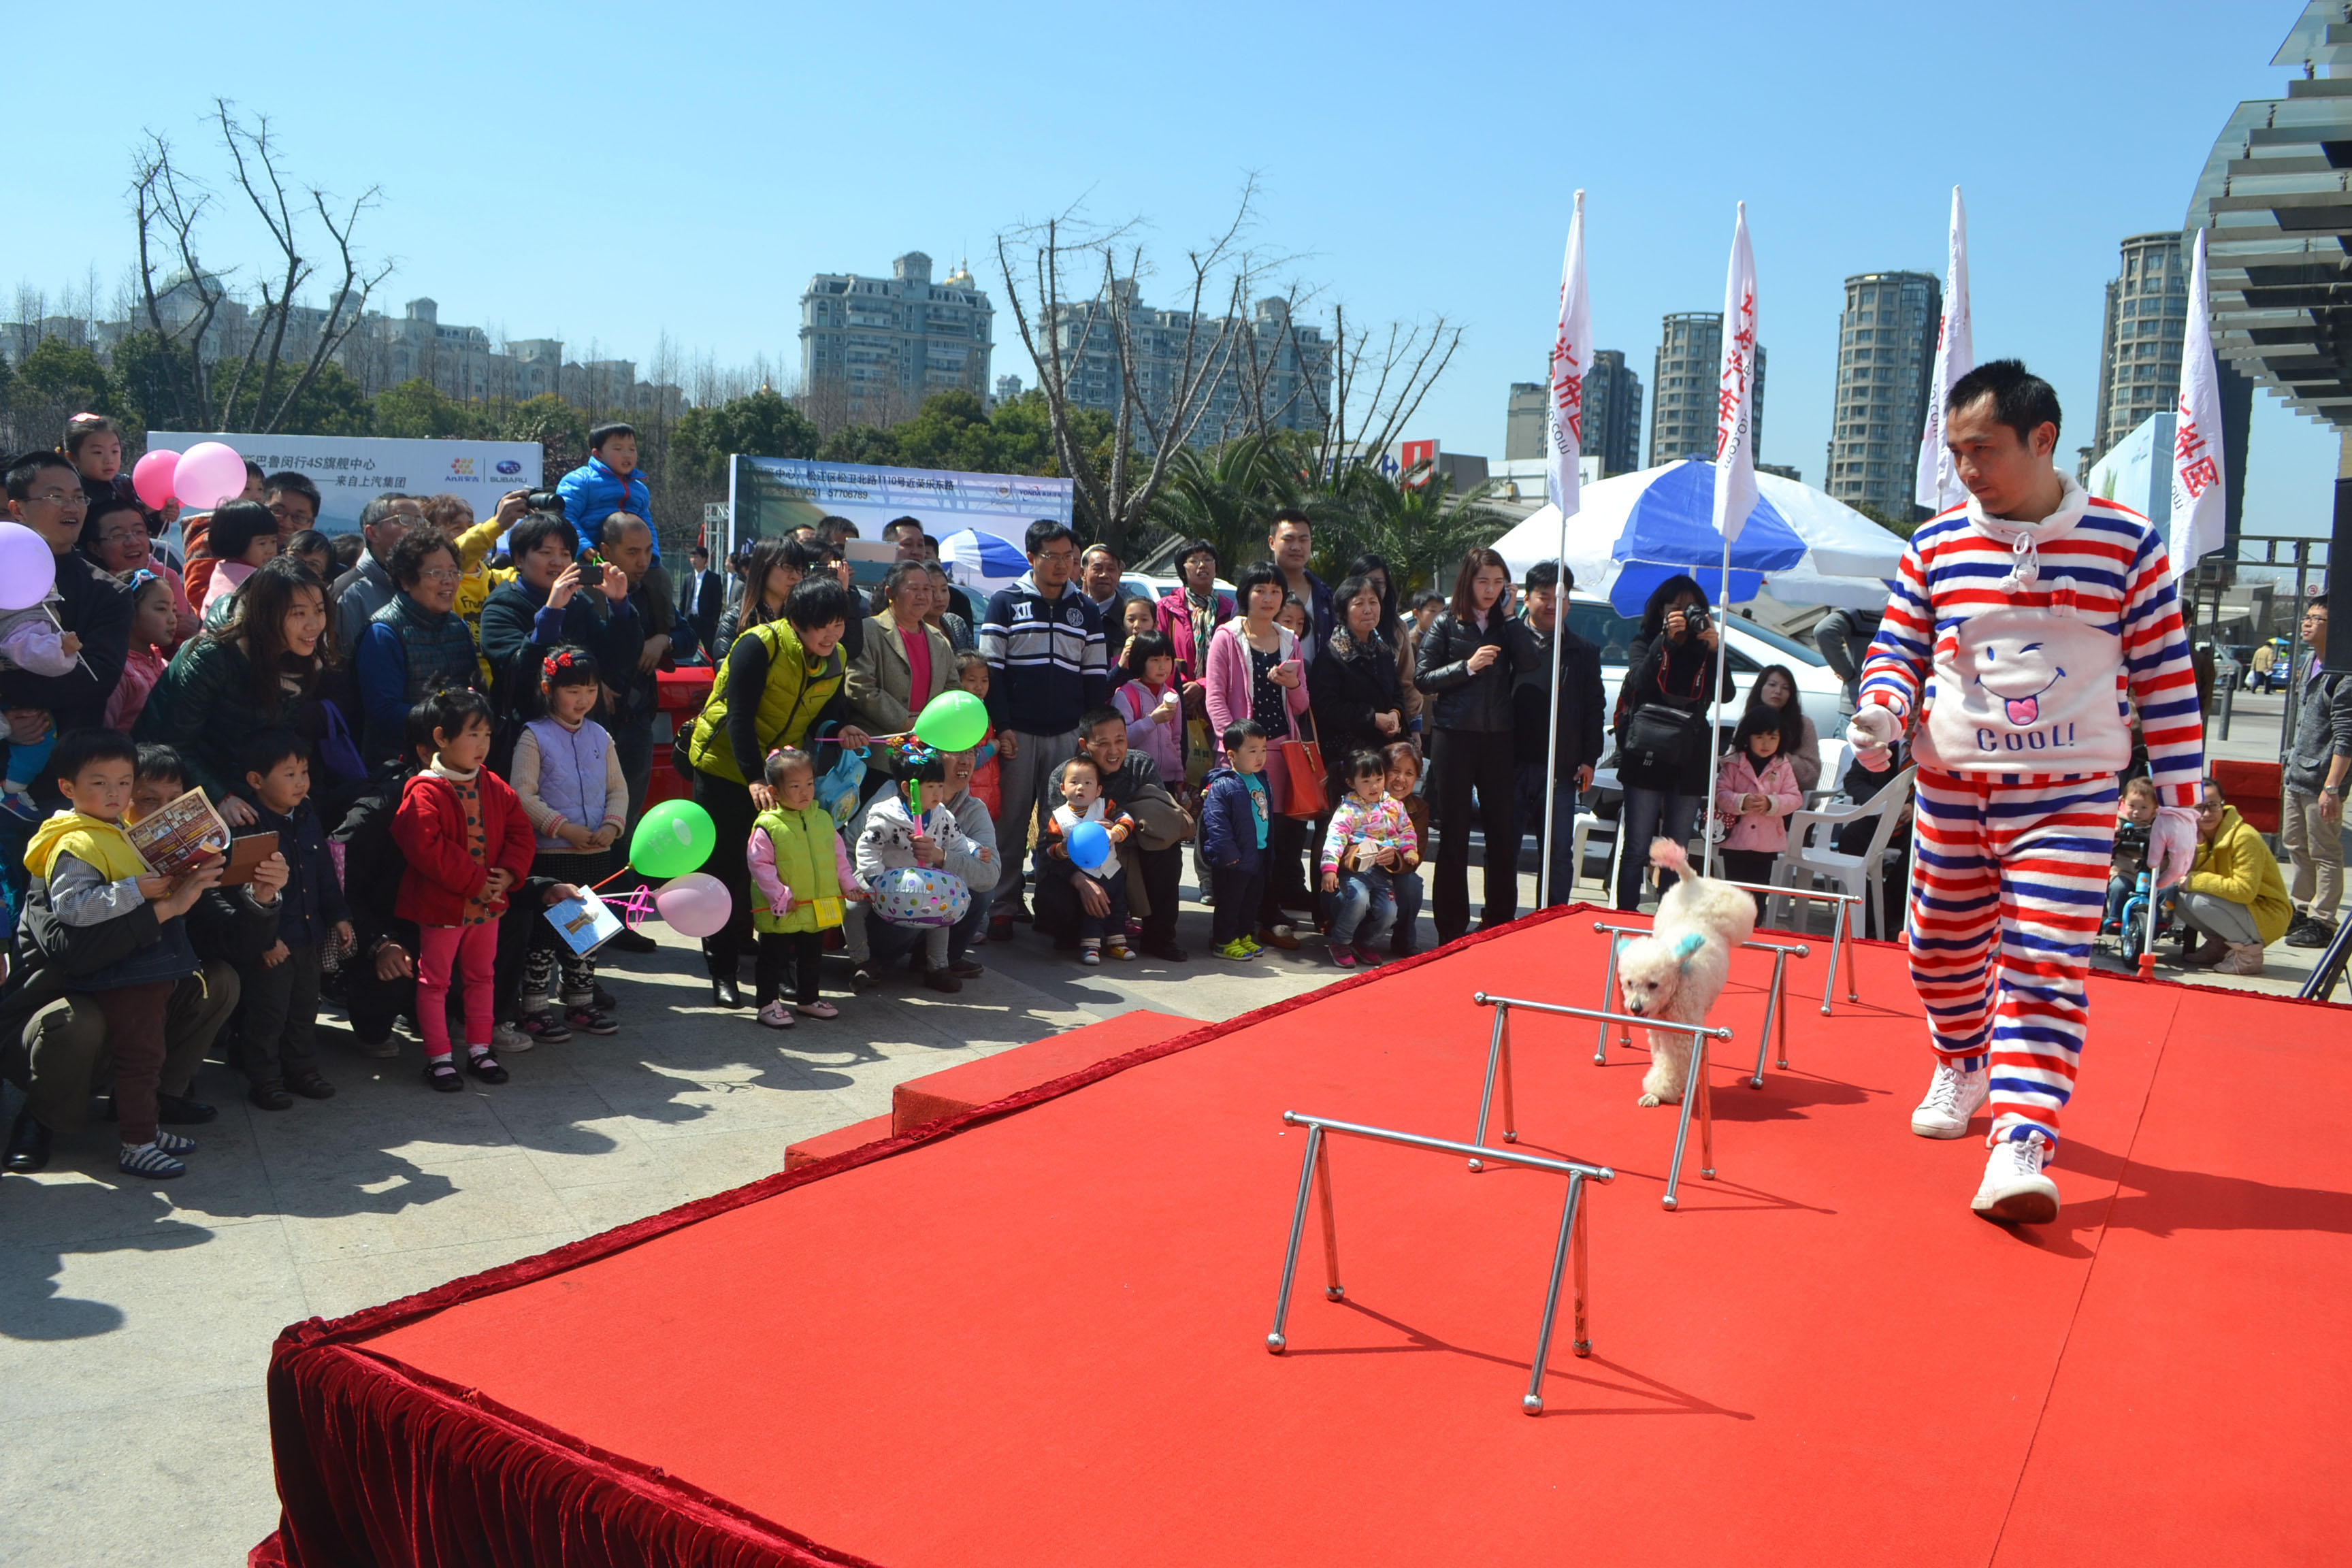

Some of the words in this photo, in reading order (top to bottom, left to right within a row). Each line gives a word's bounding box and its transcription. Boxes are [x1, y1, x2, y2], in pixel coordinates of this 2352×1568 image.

[241, 455, 376, 470] 巴鲁闵行4S旗舰中心
[1011, 601, 1034, 621] XII
